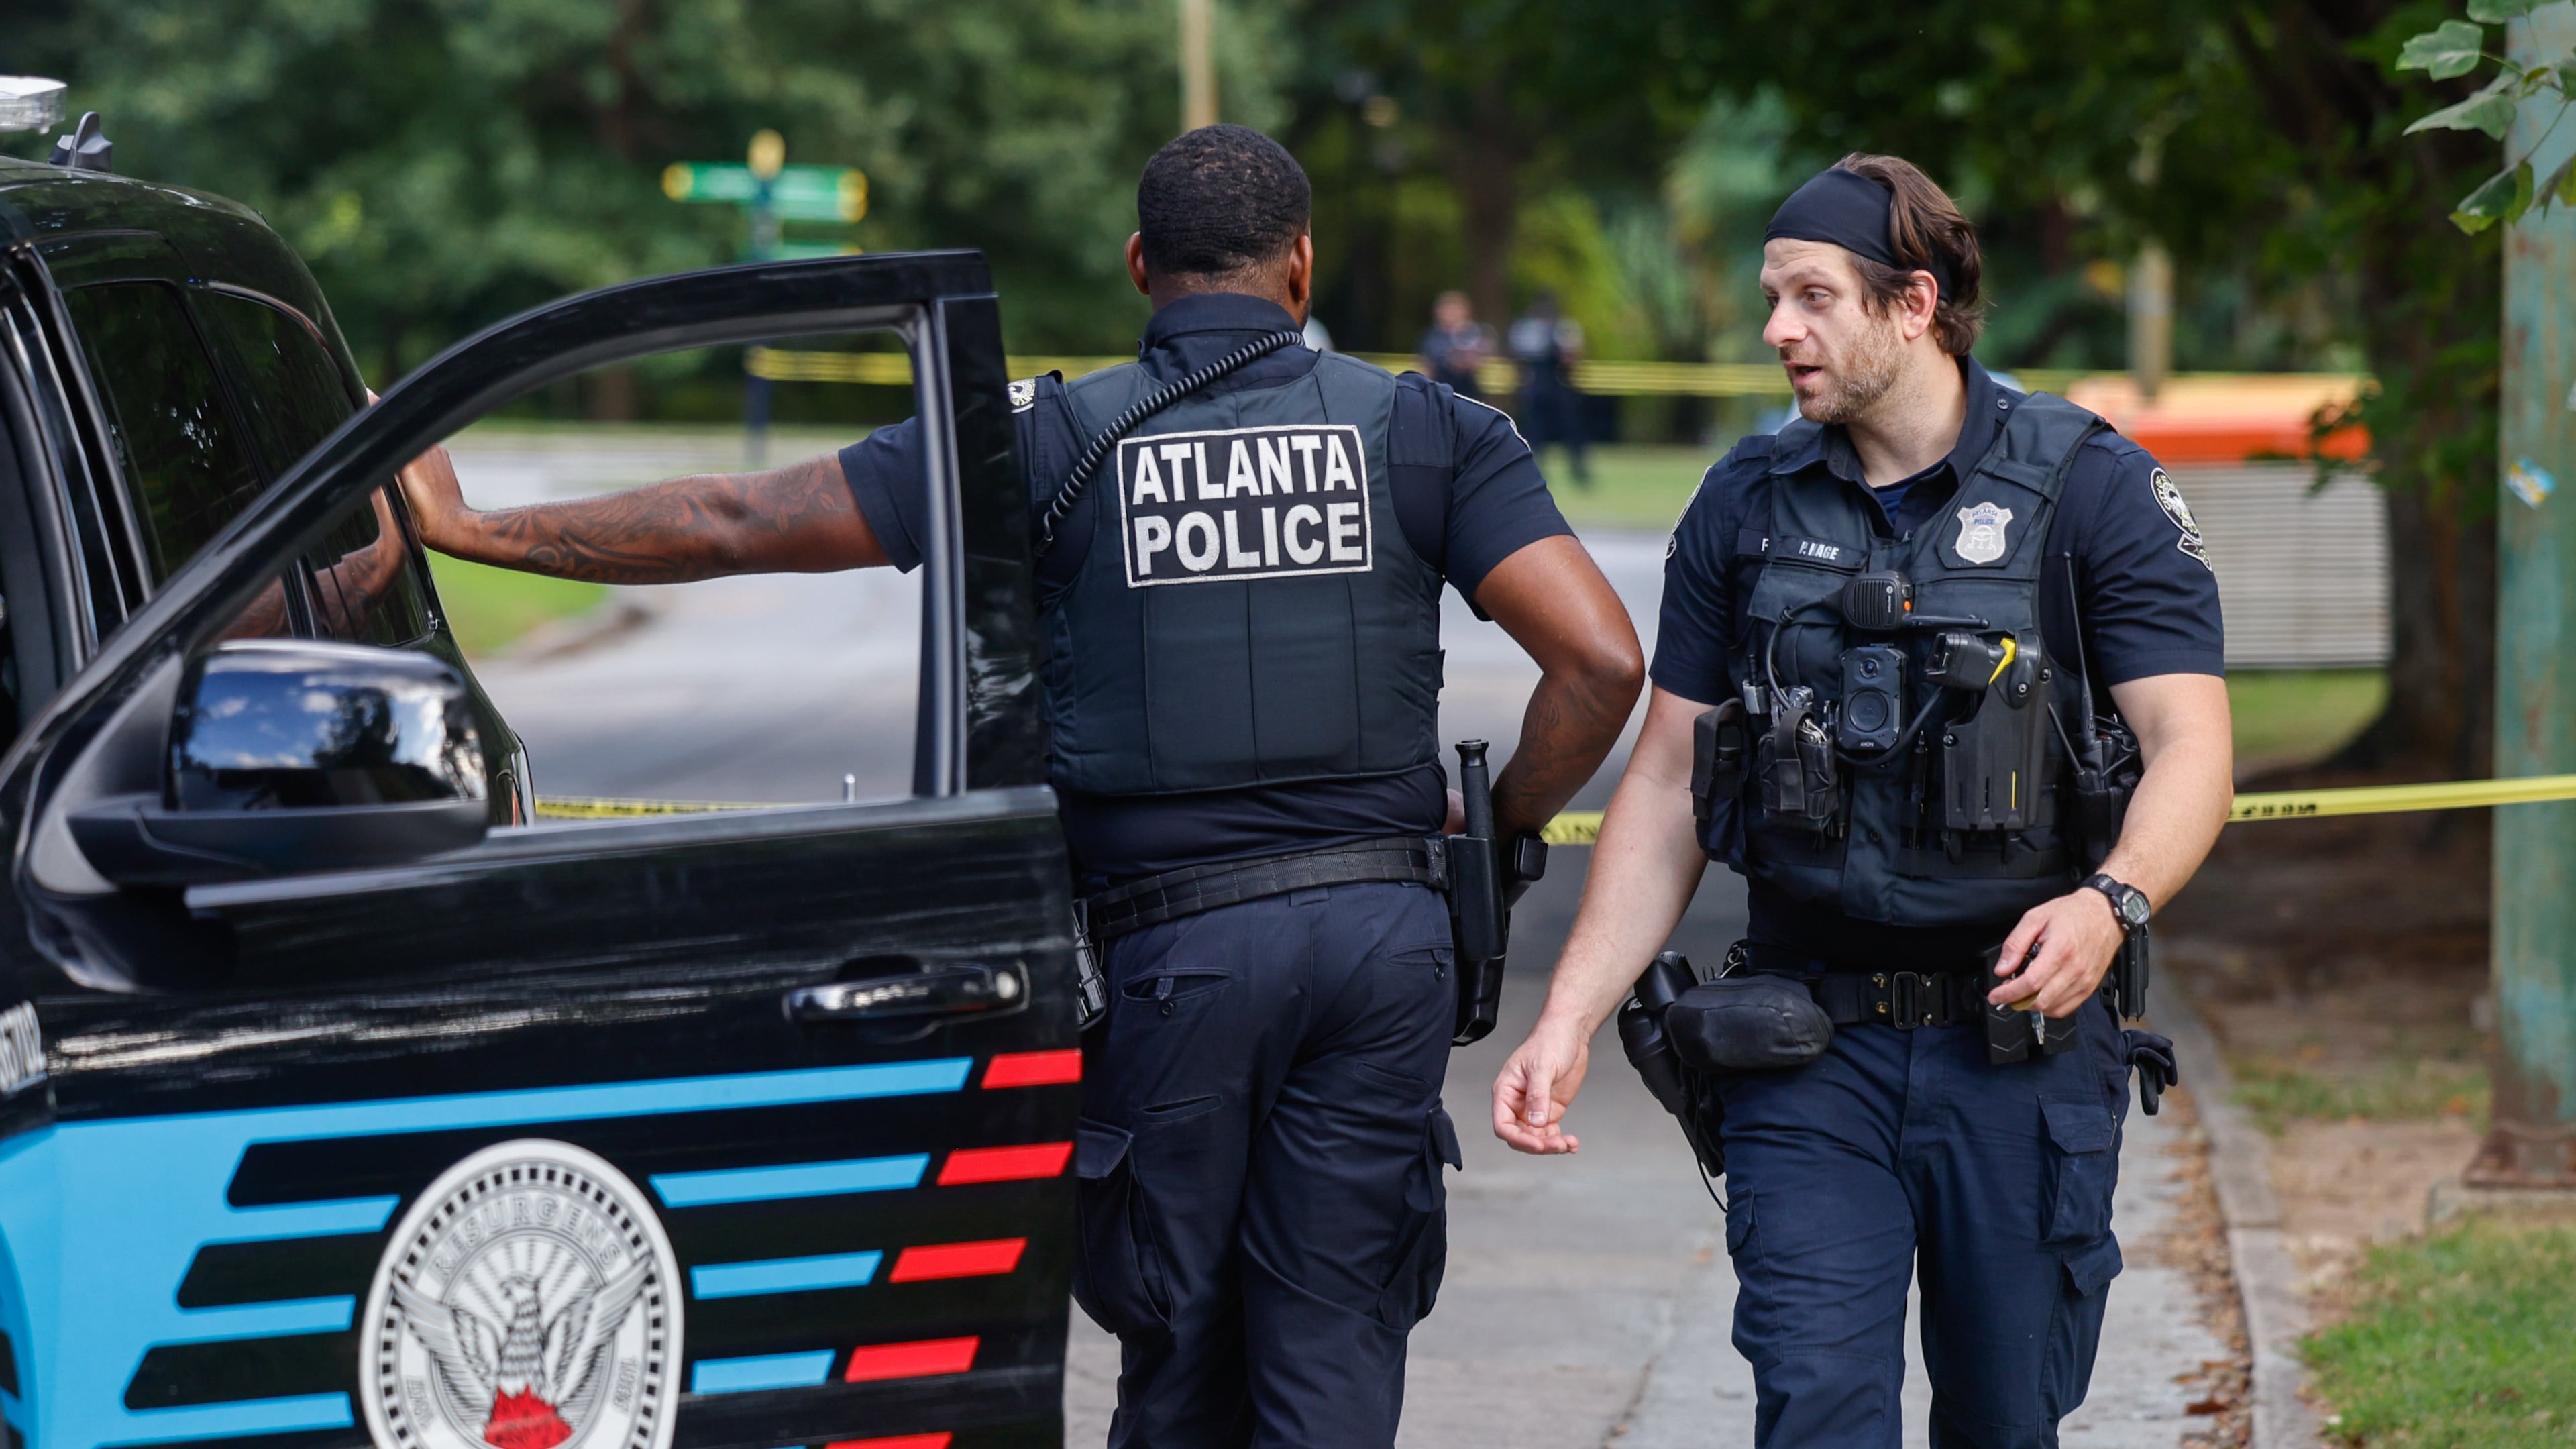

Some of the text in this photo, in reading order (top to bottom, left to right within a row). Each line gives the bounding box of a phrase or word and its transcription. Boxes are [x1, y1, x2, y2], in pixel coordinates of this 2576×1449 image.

[1132, 435, 1357, 504] ATLANTA
[1134, 502, 1362, 576] POLICE
[1972, 509, 1998, 517] ATLANTA
[430, 1197, 621, 1277] RESURGENS
